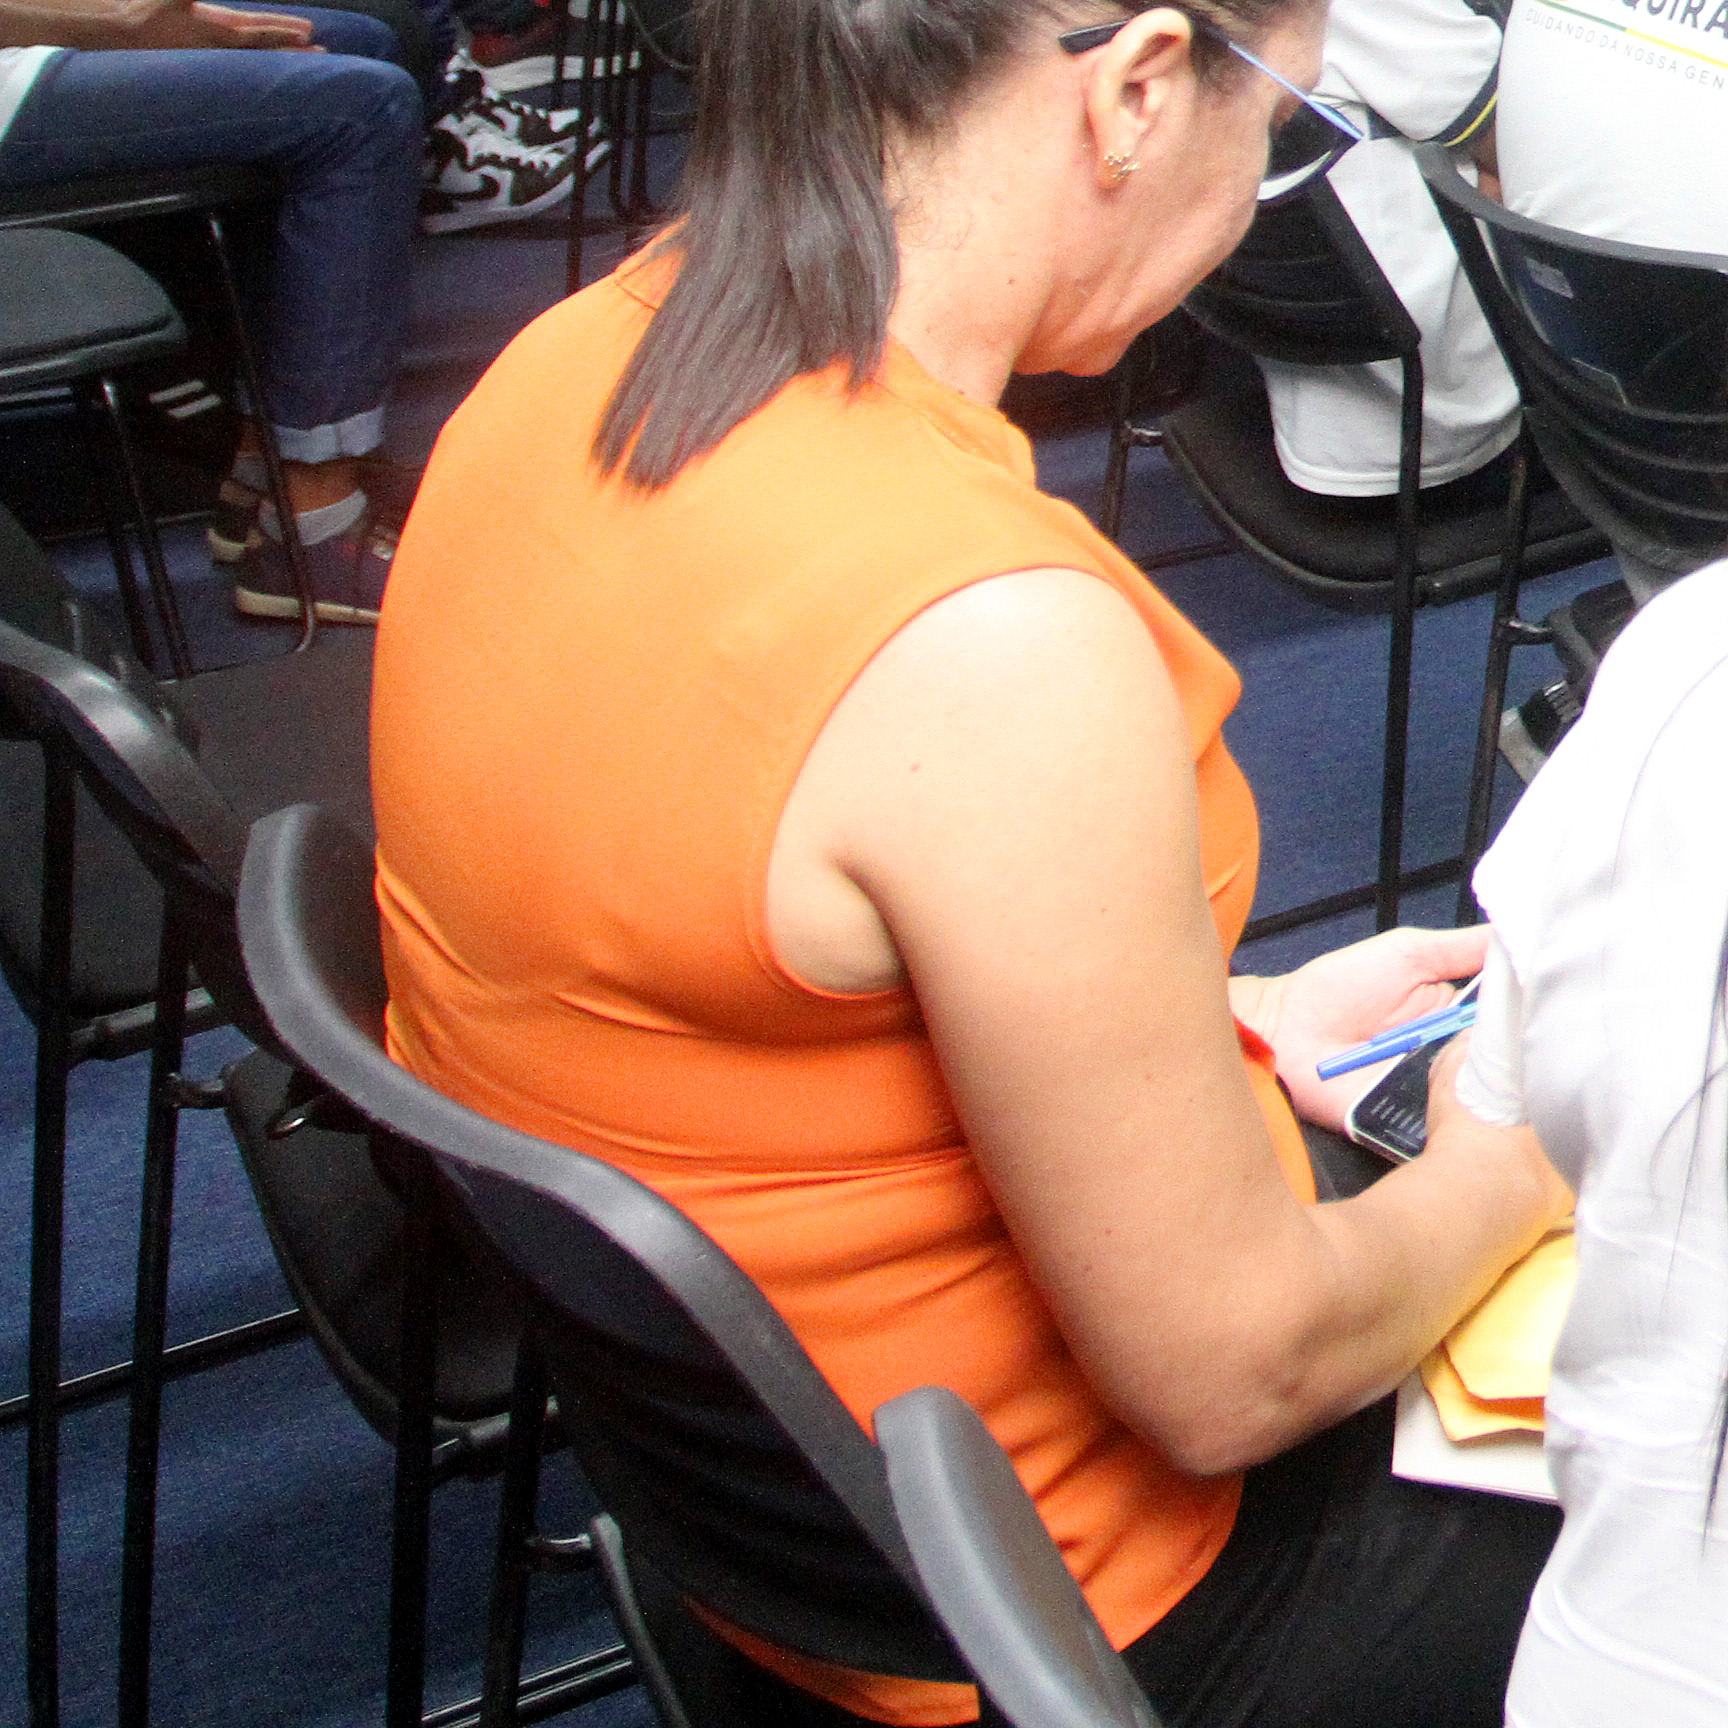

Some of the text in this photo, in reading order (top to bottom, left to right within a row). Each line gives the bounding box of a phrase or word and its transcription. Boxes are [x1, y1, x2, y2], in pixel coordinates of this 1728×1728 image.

[1526, 8, 1596, 44] CUIDANDO
[1599, 36, 1617, 52] DA
[1624, 43, 1678, 73] NOSSA
